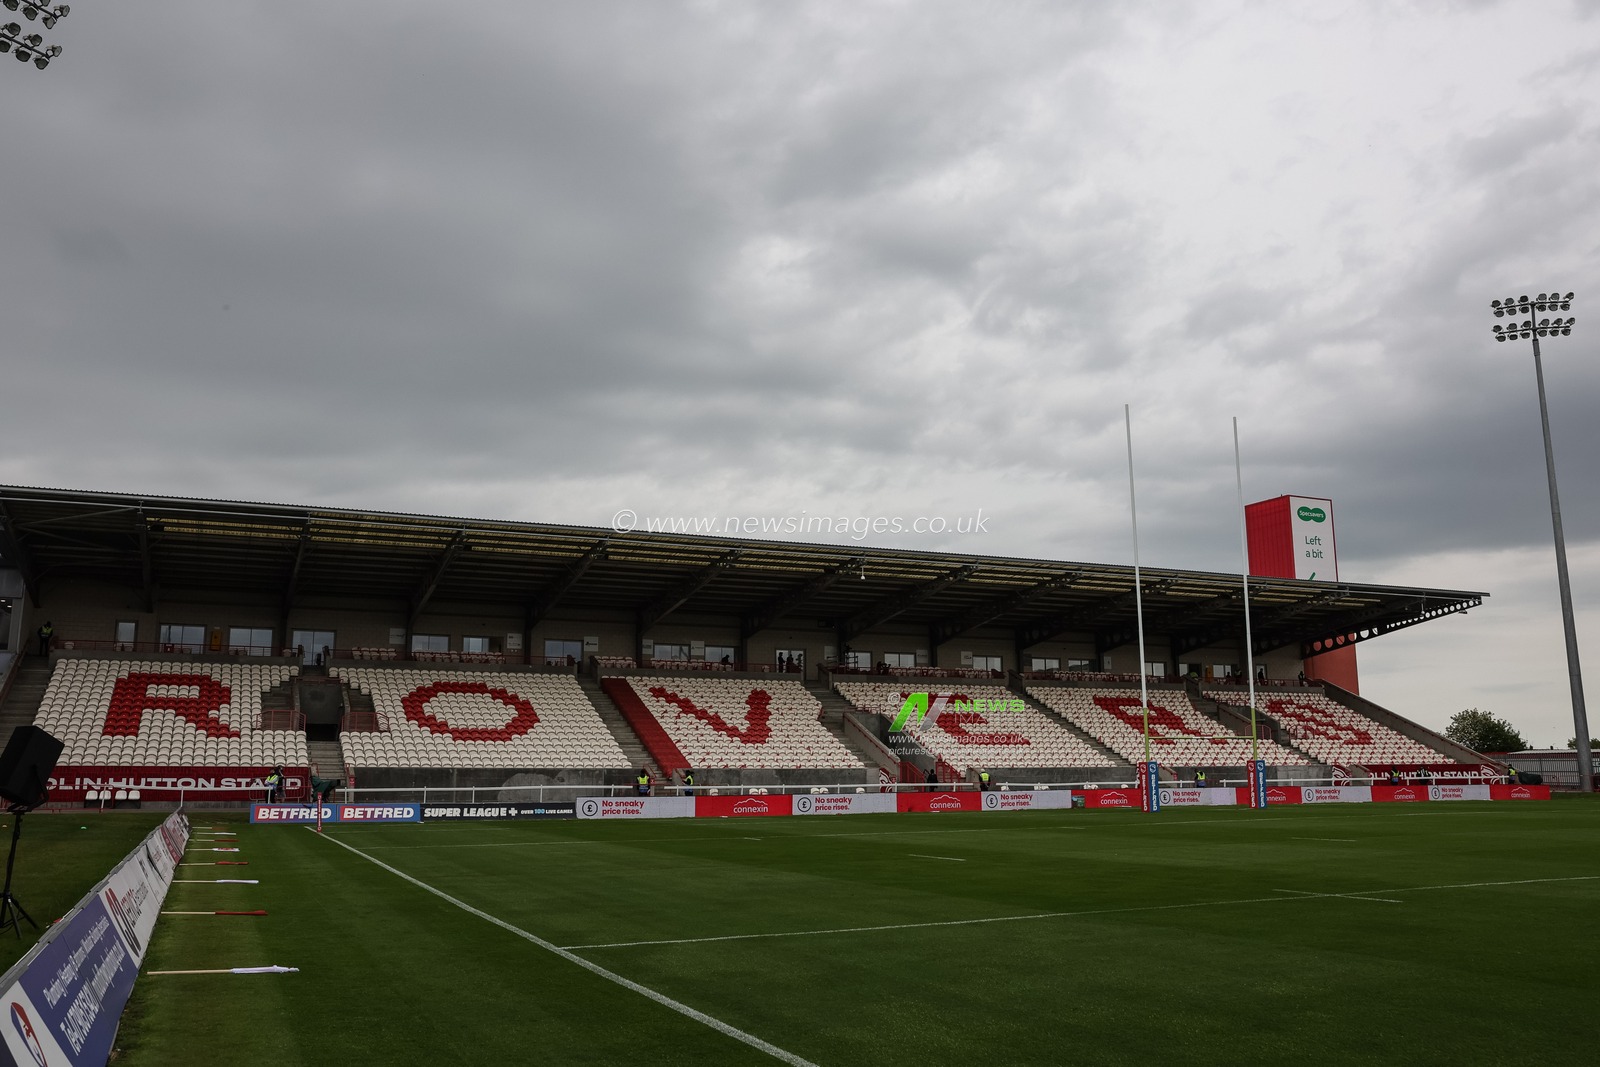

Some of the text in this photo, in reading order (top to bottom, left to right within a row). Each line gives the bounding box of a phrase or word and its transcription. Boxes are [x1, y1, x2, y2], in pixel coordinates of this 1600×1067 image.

[1299, 510, 1324, 519] Specsavers
[1304, 535, 1322, 546] Left
[1305, 549, 1324, 559] a bit
[1443, 771, 1479, 779] STAND
[46, 777, 302, 790] OLIN HUTTON STAD
[1011, 794, 1033, 802] sneaky
[1181, 790, 1201, 798] sneaky
[615, 800, 645, 809] sneaky
[826, 797, 852, 806] sneaky
[929, 801, 962, 809] connexin
[1100, 797, 1128, 805] connexin
[257, 808, 332, 820] BETFRED
[343, 807, 414, 819] BETFRED
[424, 807, 461, 818] SUPER
[463, 807, 507, 817] LEAGUE
[602, 808, 621, 817] price
[733, 805, 769, 814] connexin
